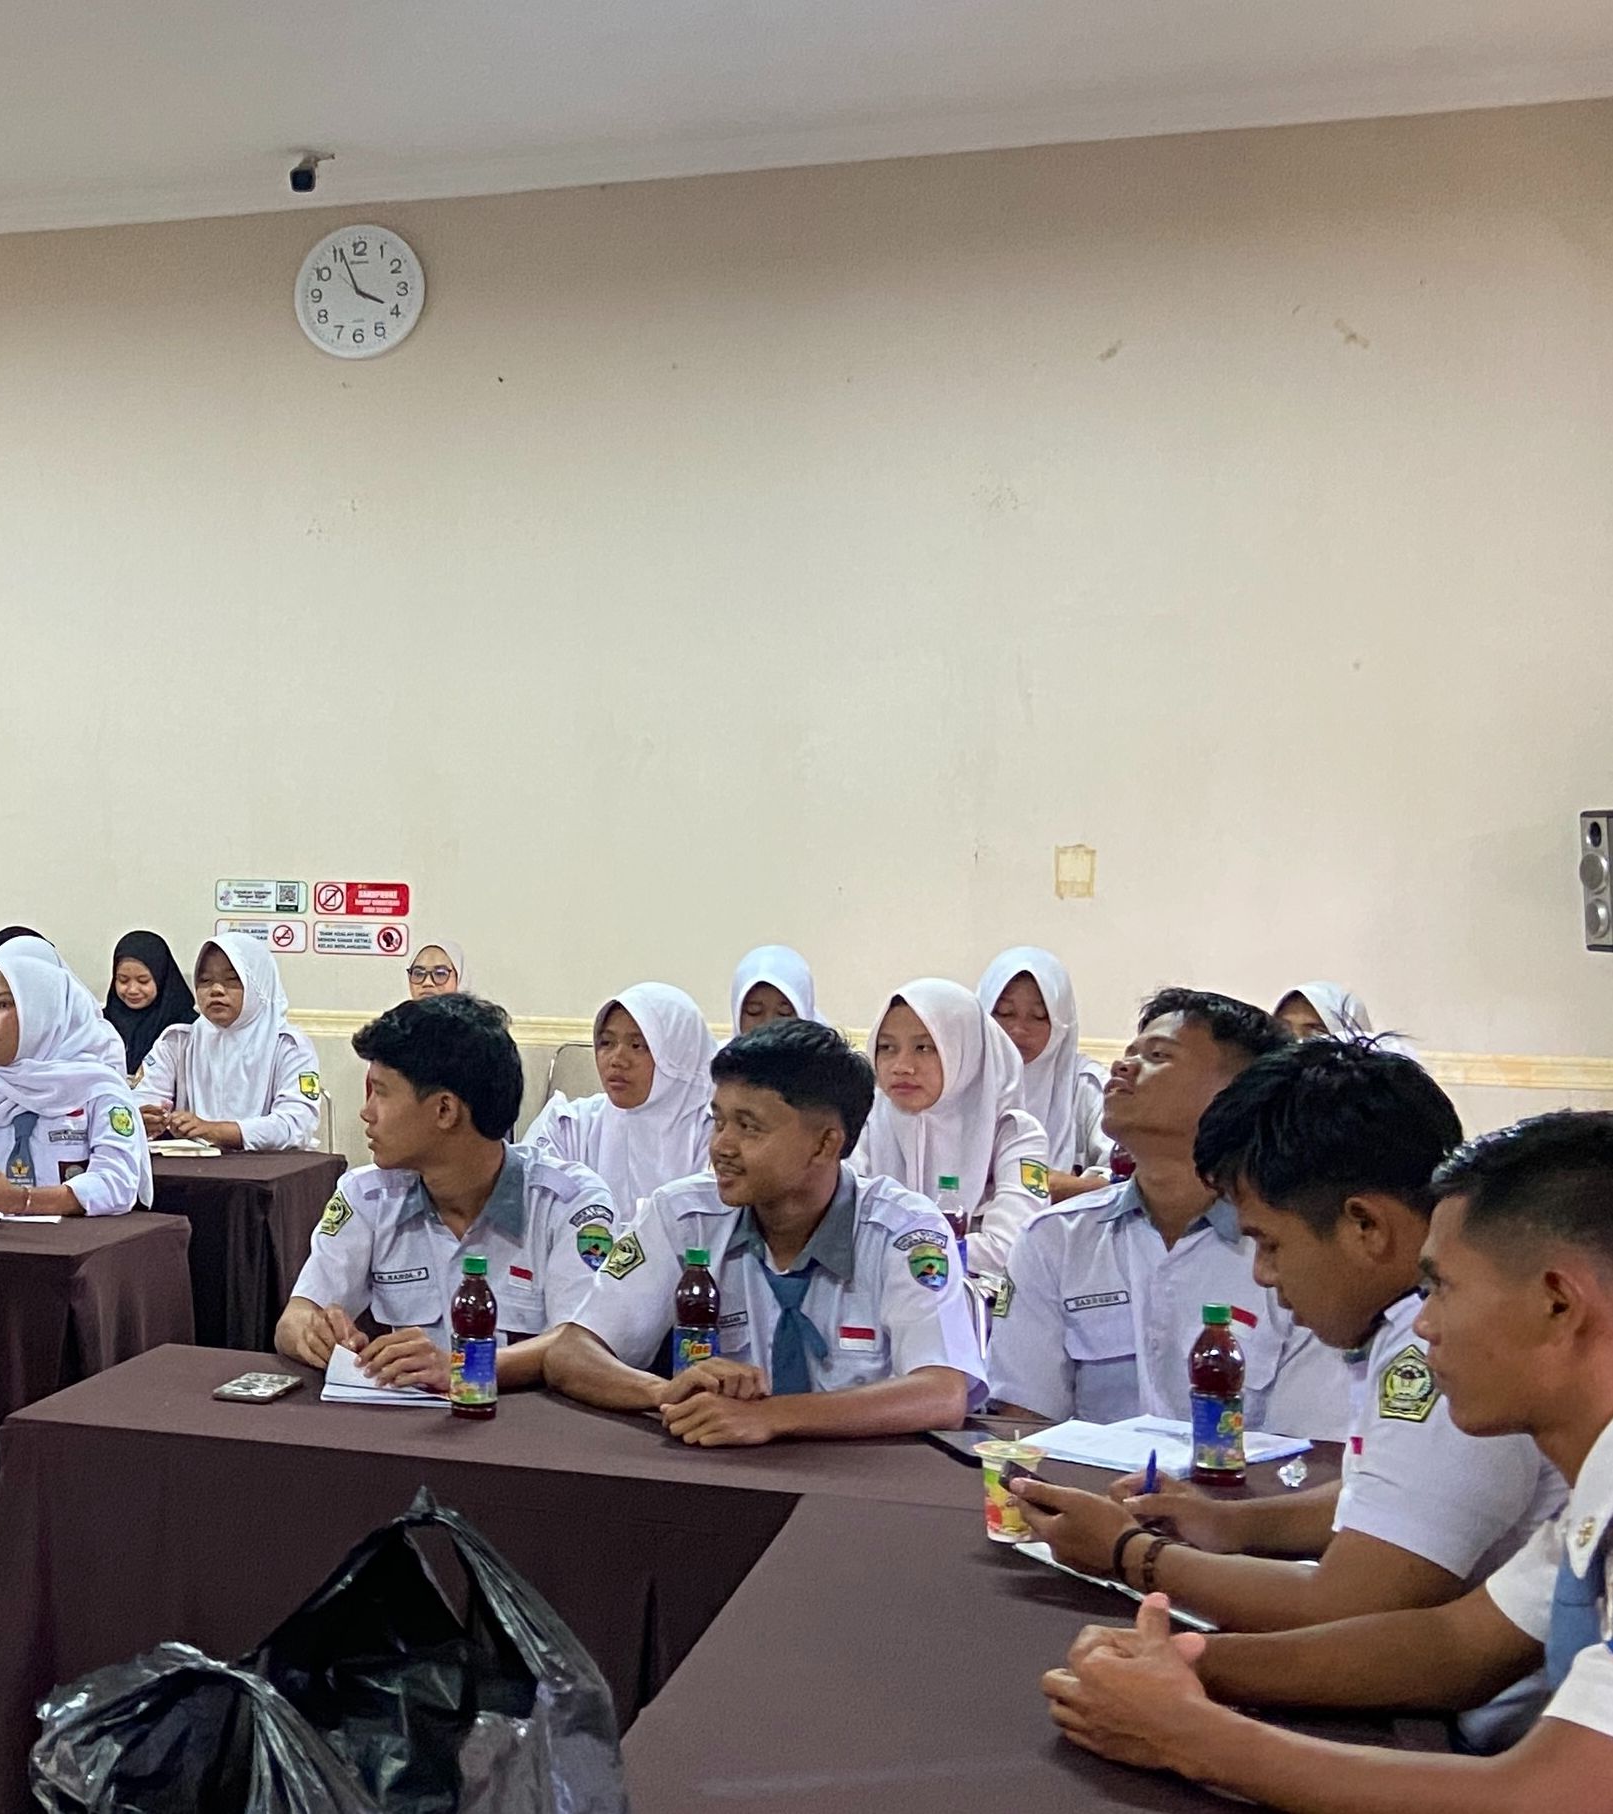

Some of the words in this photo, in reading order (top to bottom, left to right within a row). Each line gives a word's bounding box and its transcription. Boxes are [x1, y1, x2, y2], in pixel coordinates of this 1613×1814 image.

[333, 245, 344, 262] 11
[352, 241, 367, 256] 12
[379, 244, 384, 259] 1
[390, 258, 402, 274] 2
[315, 267, 332, 282] 10
[310, 288, 323, 303] 9
[396, 281, 409, 296] 3
[317, 309, 329, 324] 8
[390, 303, 402, 318] 4
[333, 325, 345, 340] 7
[352, 328, 365, 343] 6
[374, 321, 386, 337] 5
